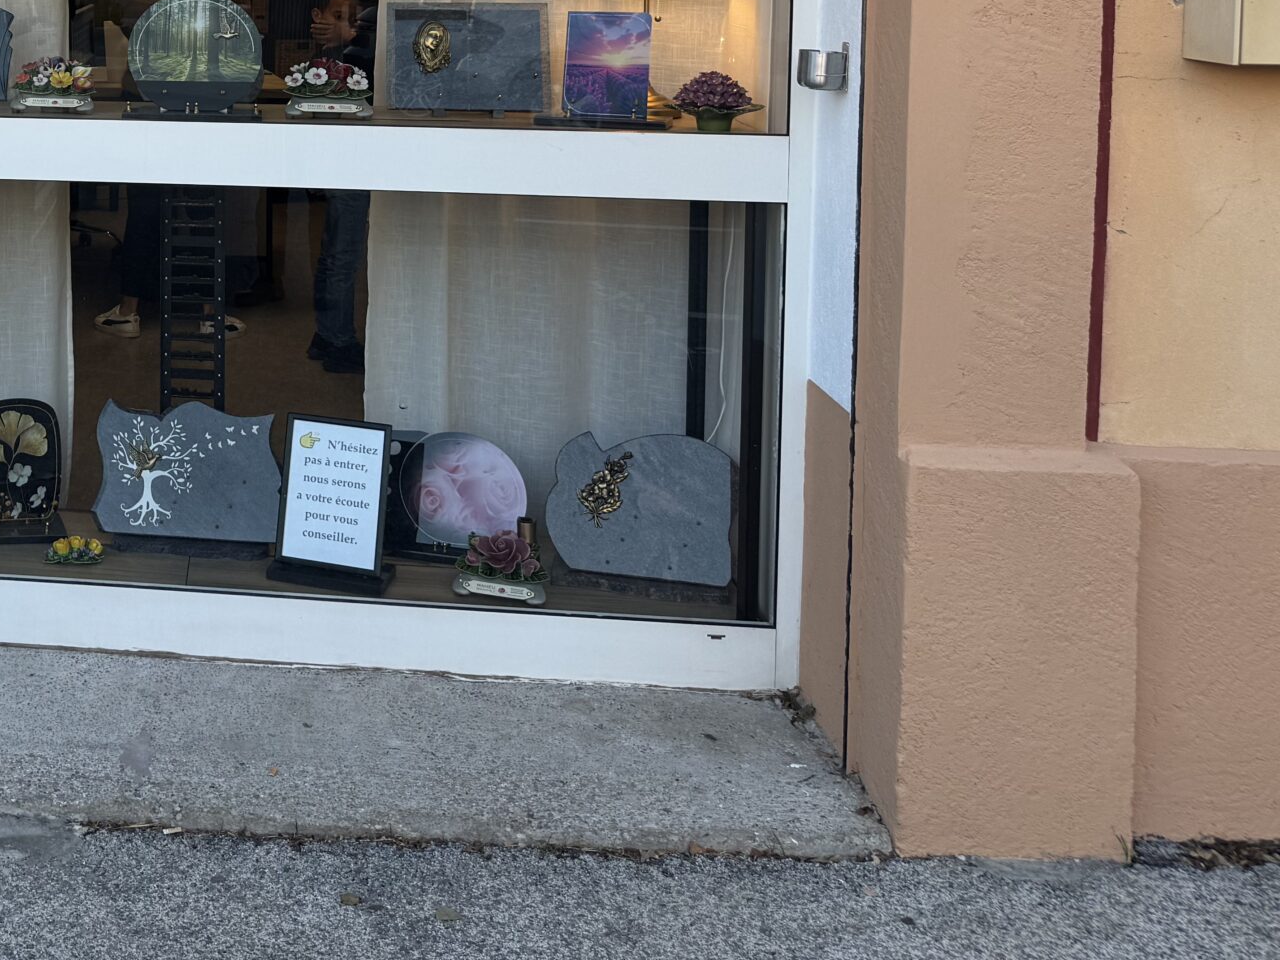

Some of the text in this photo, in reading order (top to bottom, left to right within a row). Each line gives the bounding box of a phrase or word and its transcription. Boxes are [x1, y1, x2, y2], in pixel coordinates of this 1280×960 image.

[328, 439, 378, 456] N'hésitez
[304, 456, 368, 473] pas à entrer,
[303, 474, 366, 490] nous serons
[305, 493, 332, 504] votre
[335, 496, 370, 510] écoute
[305, 511, 359, 526] pour vous
[302, 529, 358, 545] conseiller.
